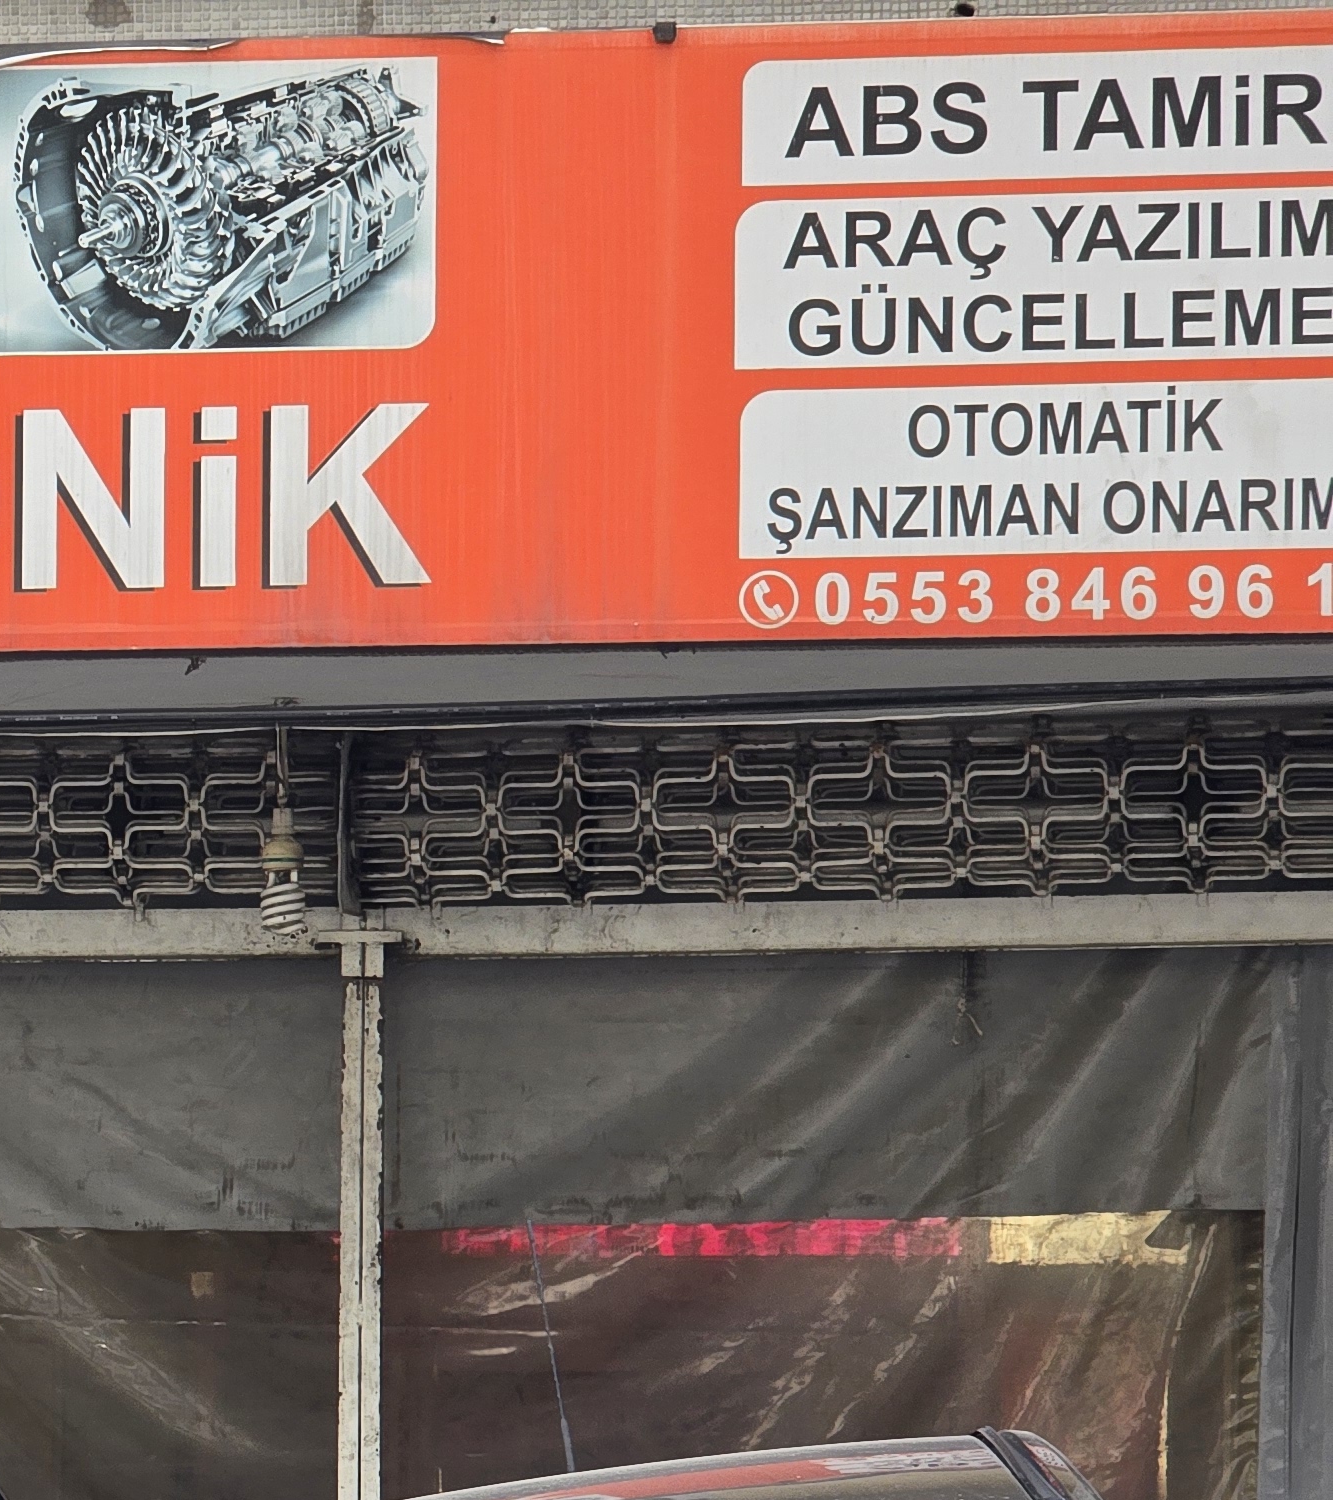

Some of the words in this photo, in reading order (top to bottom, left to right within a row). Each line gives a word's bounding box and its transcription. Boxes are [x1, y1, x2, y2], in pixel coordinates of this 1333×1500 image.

[784, 82, 988, 159] ABS
[782, 207, 1007, 280] ARAÇ
[1032, 198, 1333, 263] YAZILIM
[787, 283, 1333, 356] GÜNCELLEME
[907, 385, 1224, 457] OTOMATİK
[766, 482, 1080, 554] ŞANZIMAN
[814, 570, 994, 624] 0553
[1024, 567, 1158, 621] 846
[1187, 563, 1274, 619] 96
